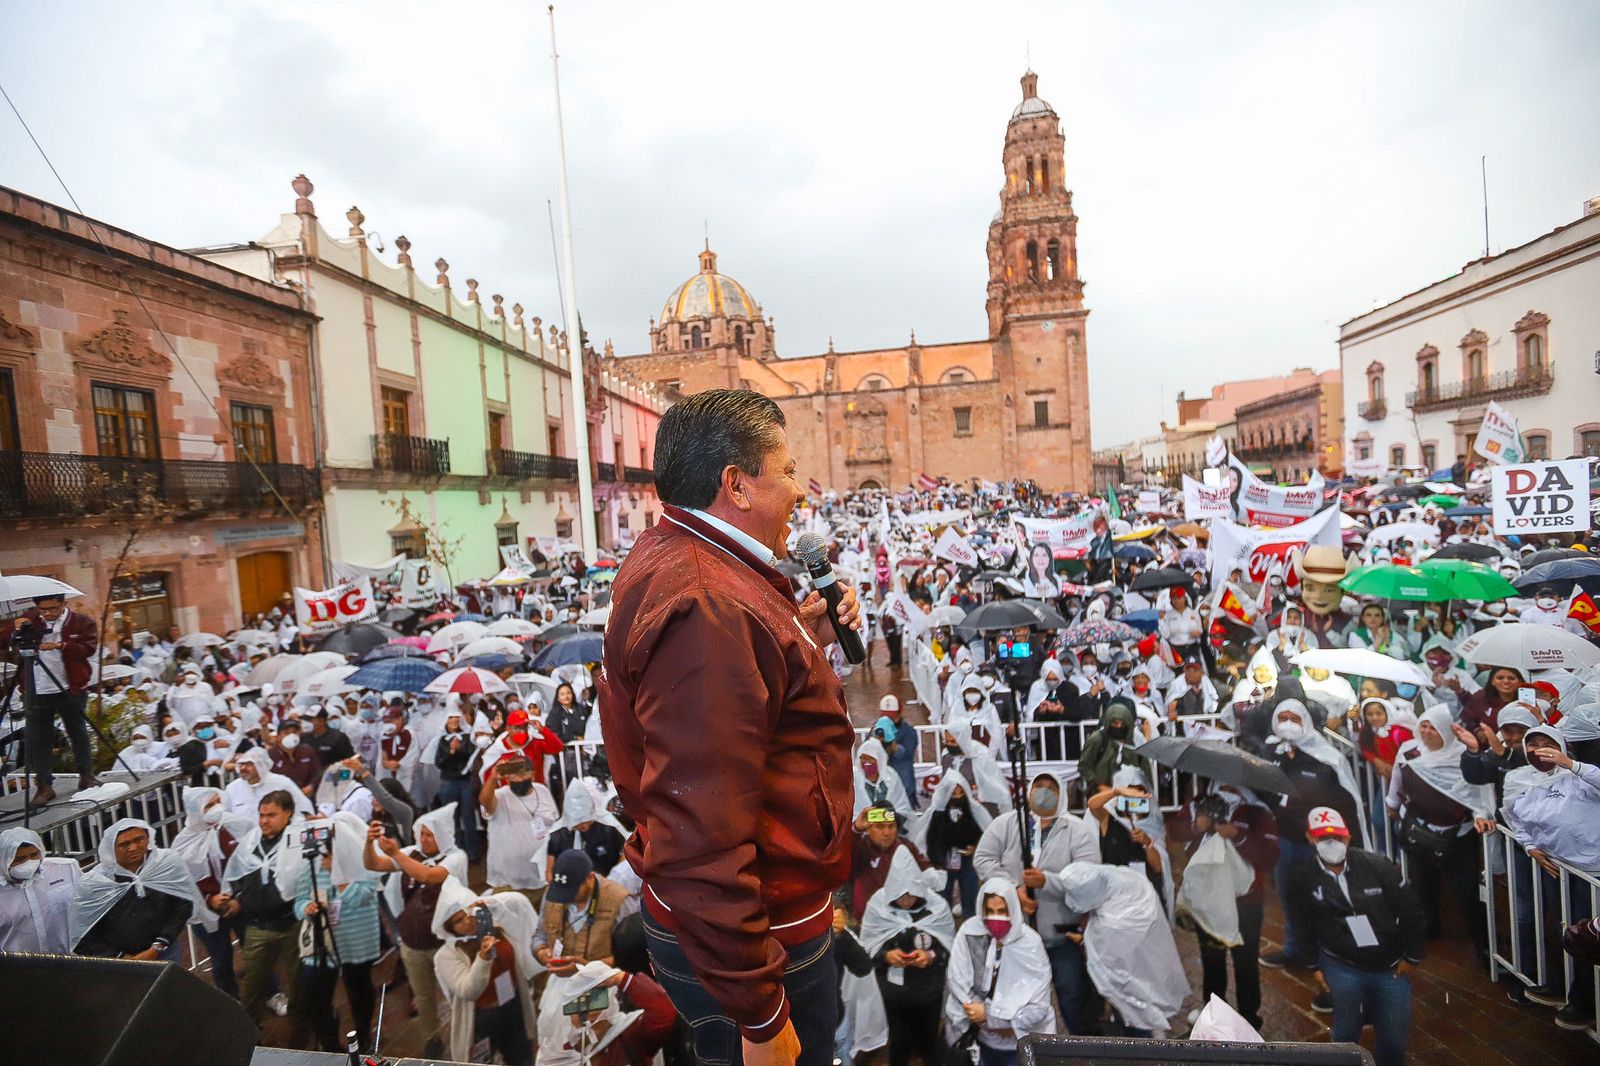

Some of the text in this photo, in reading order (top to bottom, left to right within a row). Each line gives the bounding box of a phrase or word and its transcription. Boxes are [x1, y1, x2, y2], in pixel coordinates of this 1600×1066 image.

[1505, 466, 1574, 495] DA
[1286, 490, 1316, 500] DAVID
[1505, 494, 1574, 516] VID
[1062, 527, 1088, 538] DAVID
[304, 588, 367, 622] DG
